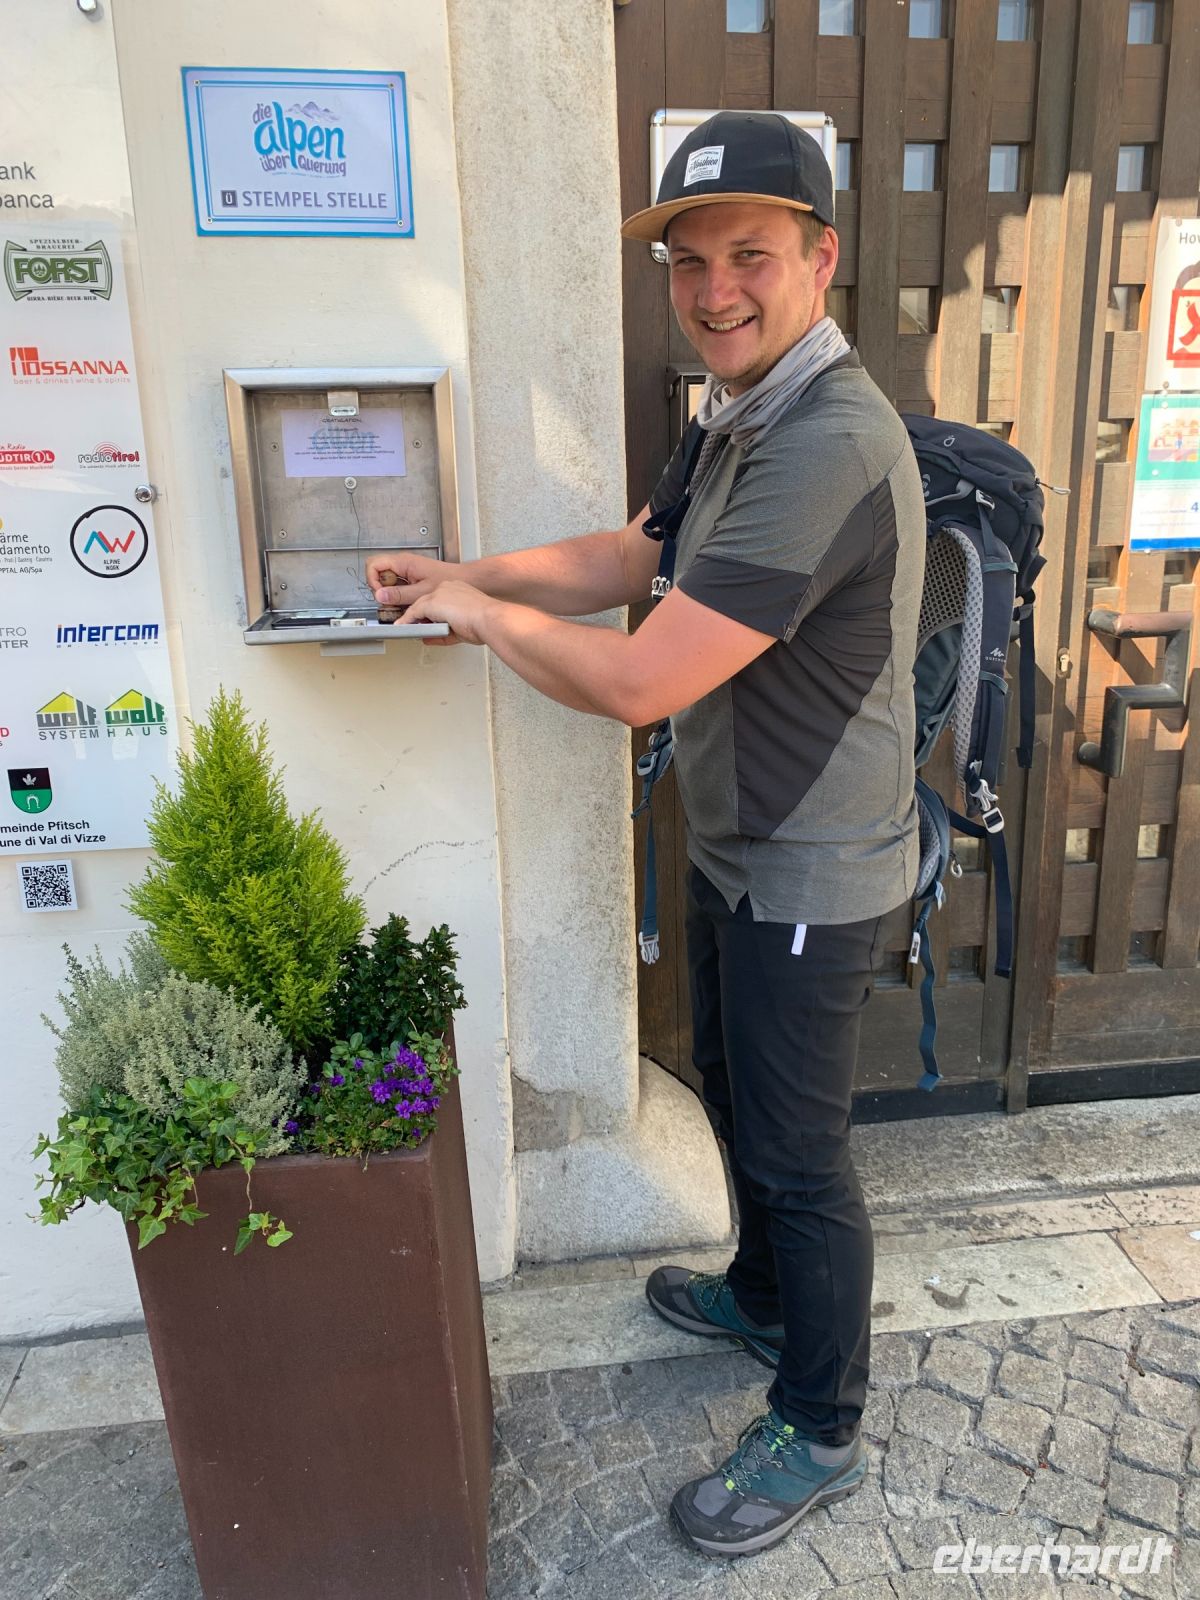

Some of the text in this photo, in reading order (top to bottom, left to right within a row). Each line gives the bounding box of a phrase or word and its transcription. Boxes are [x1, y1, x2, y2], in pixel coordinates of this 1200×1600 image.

[252, 103, 272, 124] die
[254, 101, 346, 169] alpen
[260, 154, 290, 172] über
[242, 190, 323, 208] STEMPEL
[327, 192, 388, 208] STELLE
[14, 257, 102, 284] FORST
[57, 624, 159, 643] intercom
[38, 729, 99, 741] SYSTEM
[107, 726, 168, 738] HAUS
[48, 819, 90, 831] Pfitsch
[25, 836, 36, 847] di
[39, 835, 57, 846] Val
[61, 834, 71, 845] di
[74, 833, 106, 843] Vizze
